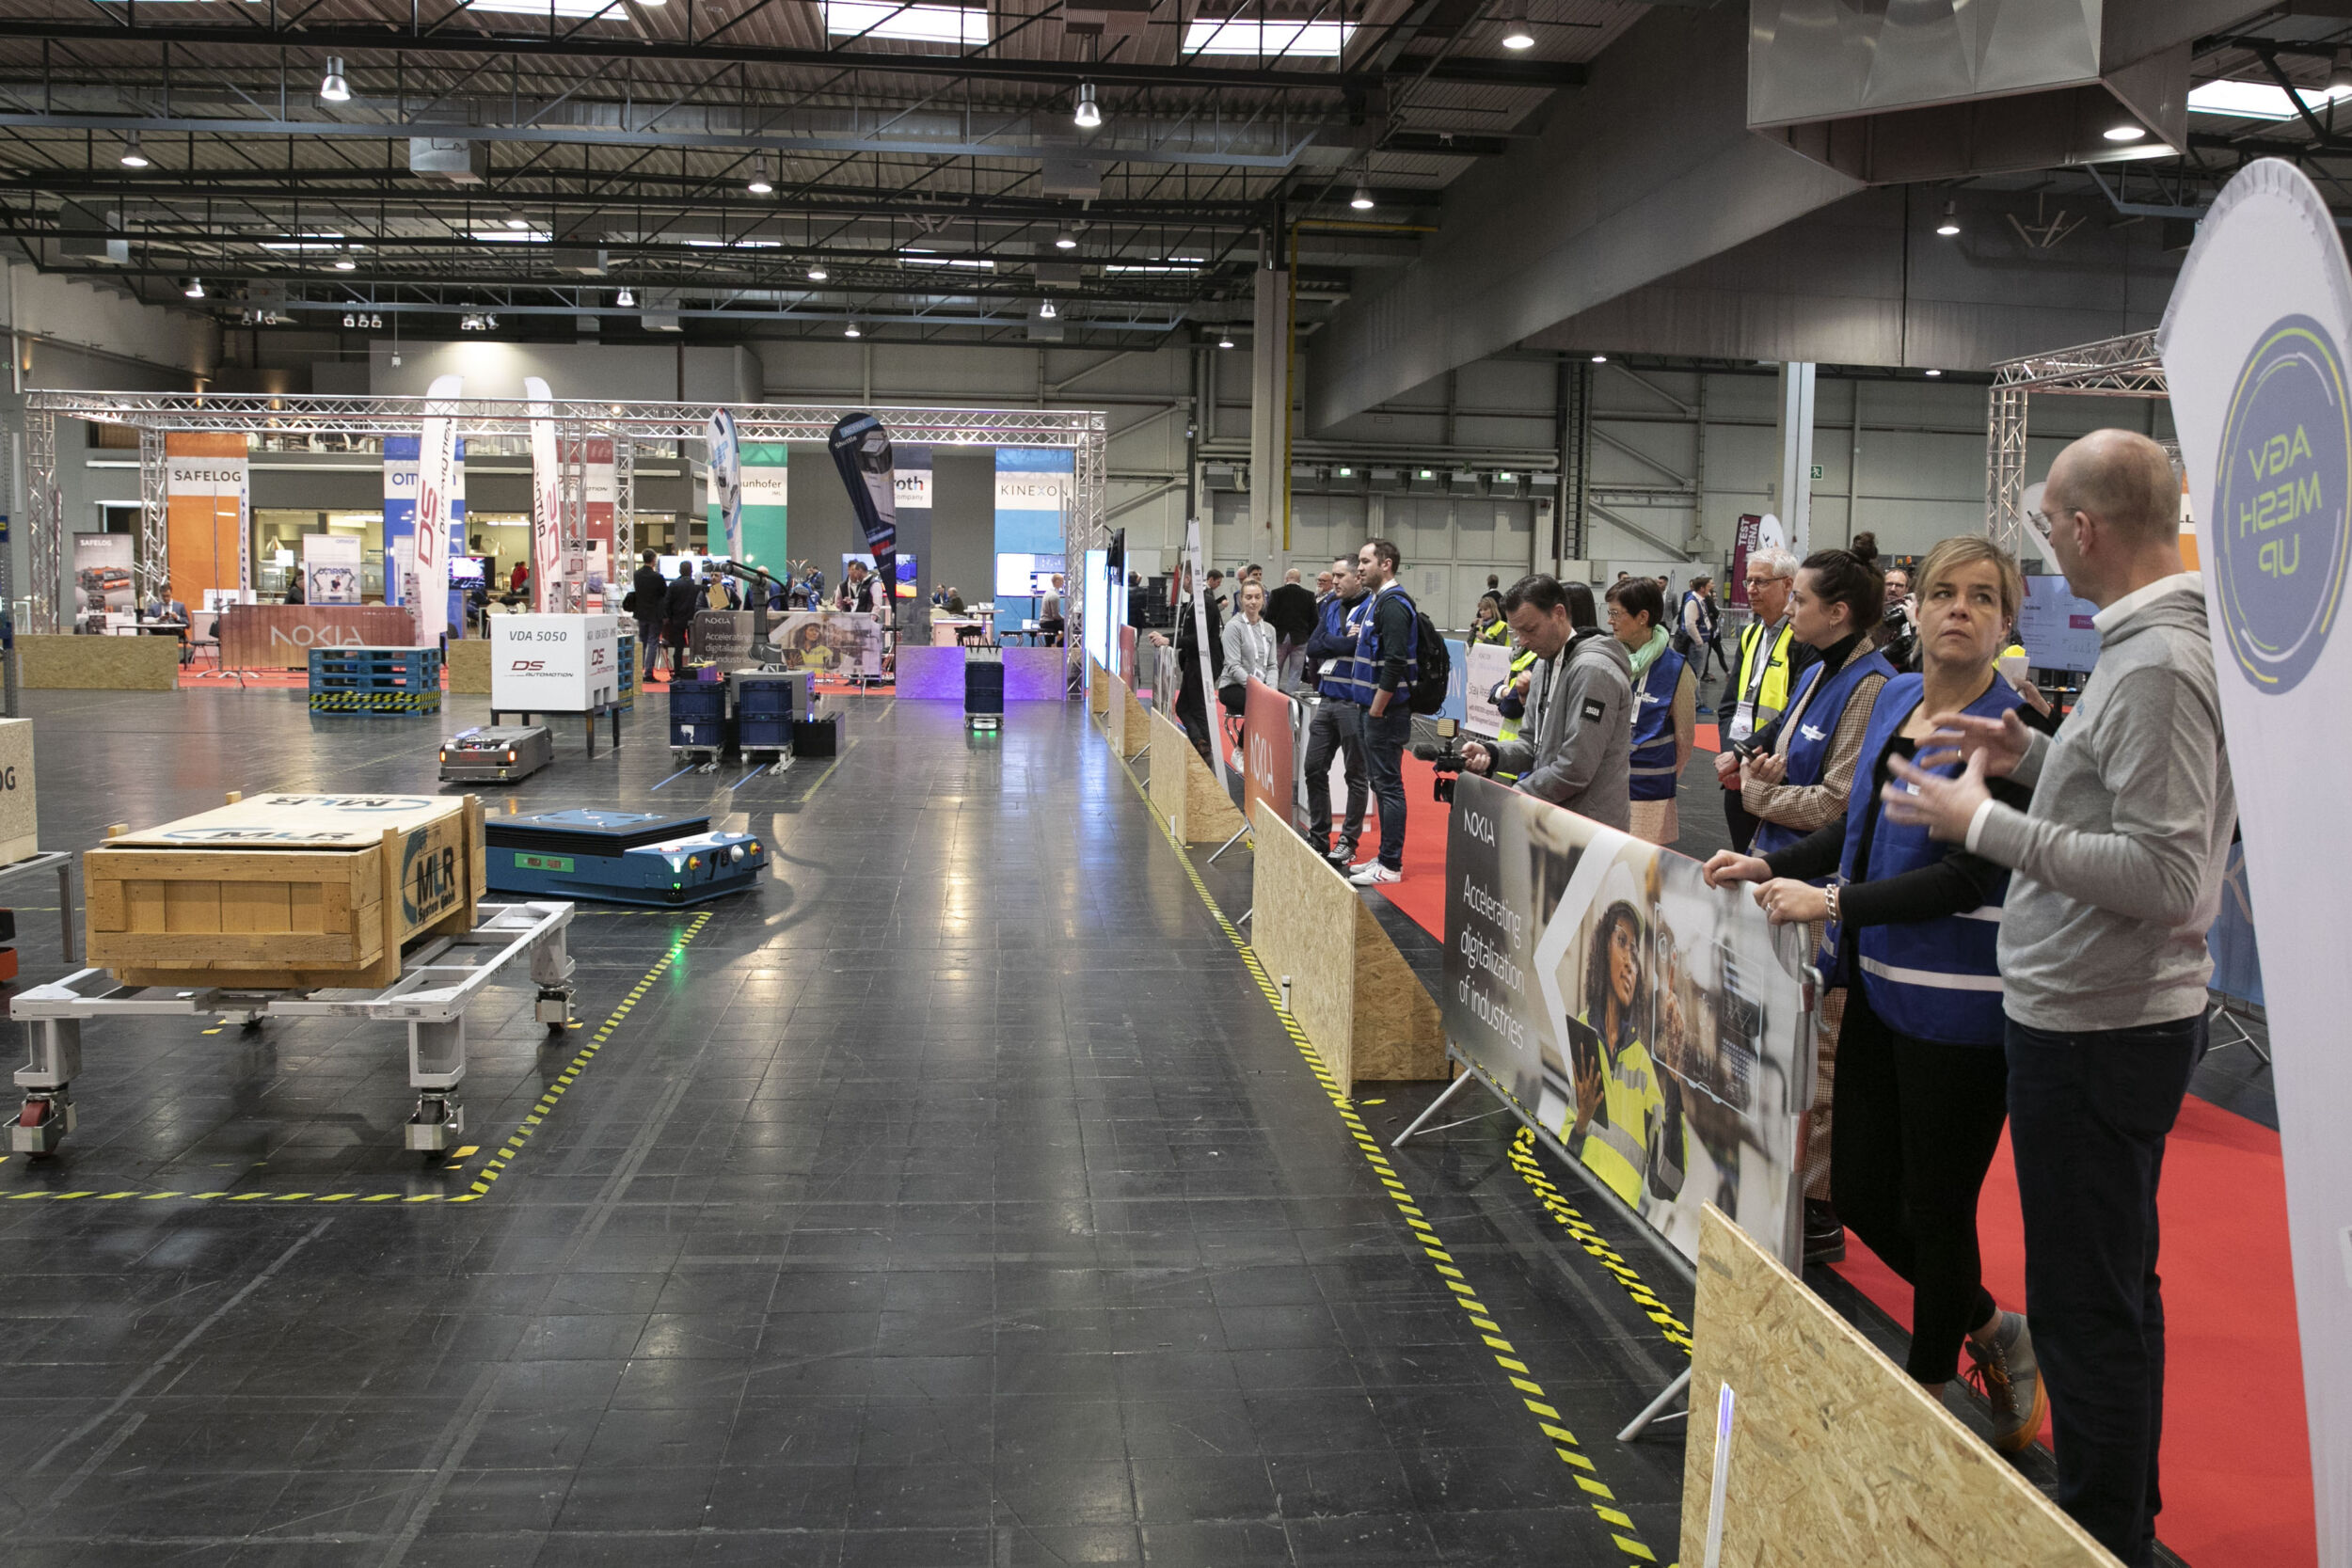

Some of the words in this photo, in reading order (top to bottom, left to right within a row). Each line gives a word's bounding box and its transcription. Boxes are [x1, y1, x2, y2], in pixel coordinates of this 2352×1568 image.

[174, 470, 242, 482] SAFELOG
[1000, 484, 1069, 497] KINEXON
[419, 480, 438, 568] DS
[1738, 518, 1750, 546] TEST
[1746, 523, 1759, 552] RENA
[271, 625, 365, 646] NOKIA
[509, 630, 532, 641] VDA
[536, 631, 567, 641] 5050
[706, 643, 751, 654] digitalizatio
[511, 660, 546, 671] DS
[1250, 729, 1274, 798] NOKIA
[1464, 807, 1495, 847] NOKIA
[417, 847, 455, 907] MLR
[1463, 874, 1521, 950] Accelerating
[1460, 923, 1525, 995] digitalization
[1459, 974, 1470, 1008] of
[1471, 981, 1524, 1050] industries
